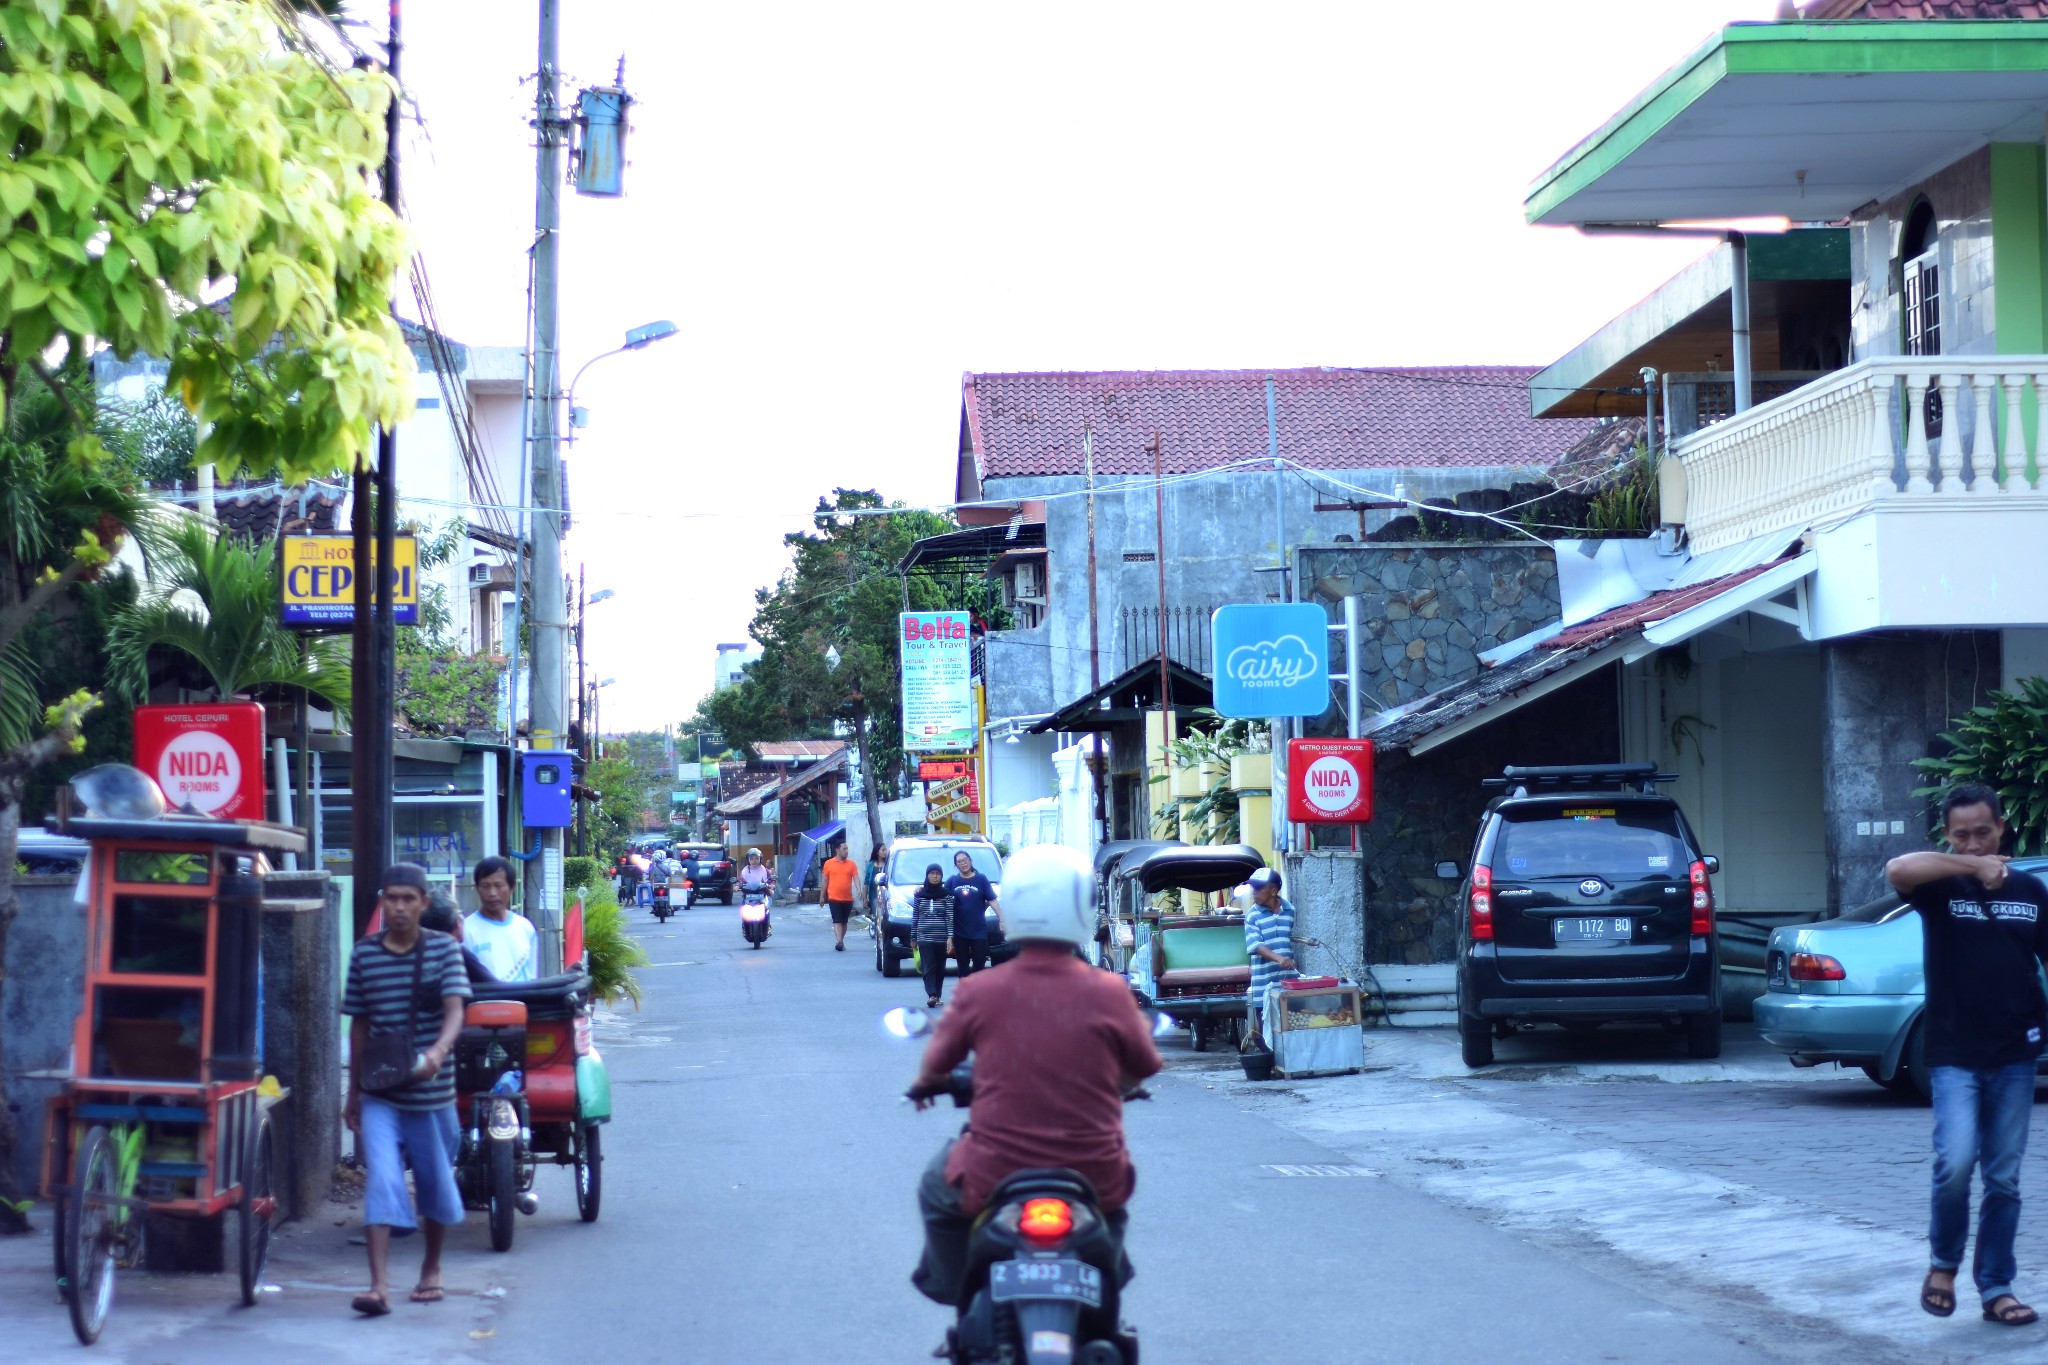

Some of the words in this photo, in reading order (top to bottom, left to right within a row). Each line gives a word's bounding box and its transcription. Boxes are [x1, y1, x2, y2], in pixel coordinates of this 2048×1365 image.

[288, 565, 411, 598] CEPI
[905, 616, 966, 640] Belfa
[906, 641, 926, 650] Tour
[929, 641, 936, 649] &
[939, 640, 967, 649] Travel
[1238, 650, 1302, 687] airy
[1242, 680, 1280, 688] rooms
[194, 714, 229, 722] CEPURI
[168, 751, 229, 777] NIDA
[179, 781, 220, 792] ROOMS
[1311, 770, 1352, 787] NIDA
[1318, 789, 1346, 798] ROOMS
[930, 807, 948, 819] TRAIN
[948, 797, 969, 811] TICKET
[1306, 802, 1318, 813] GOOD
[1334, 809, 1350, 818] EVERY
[405, 832, 472, 852] LOKAL
[1952, 903, 2036, 918] GUNUGKIDUL
[1557, 921, 1565, 934] F
[1579, 919, 1604, 933] 1172
